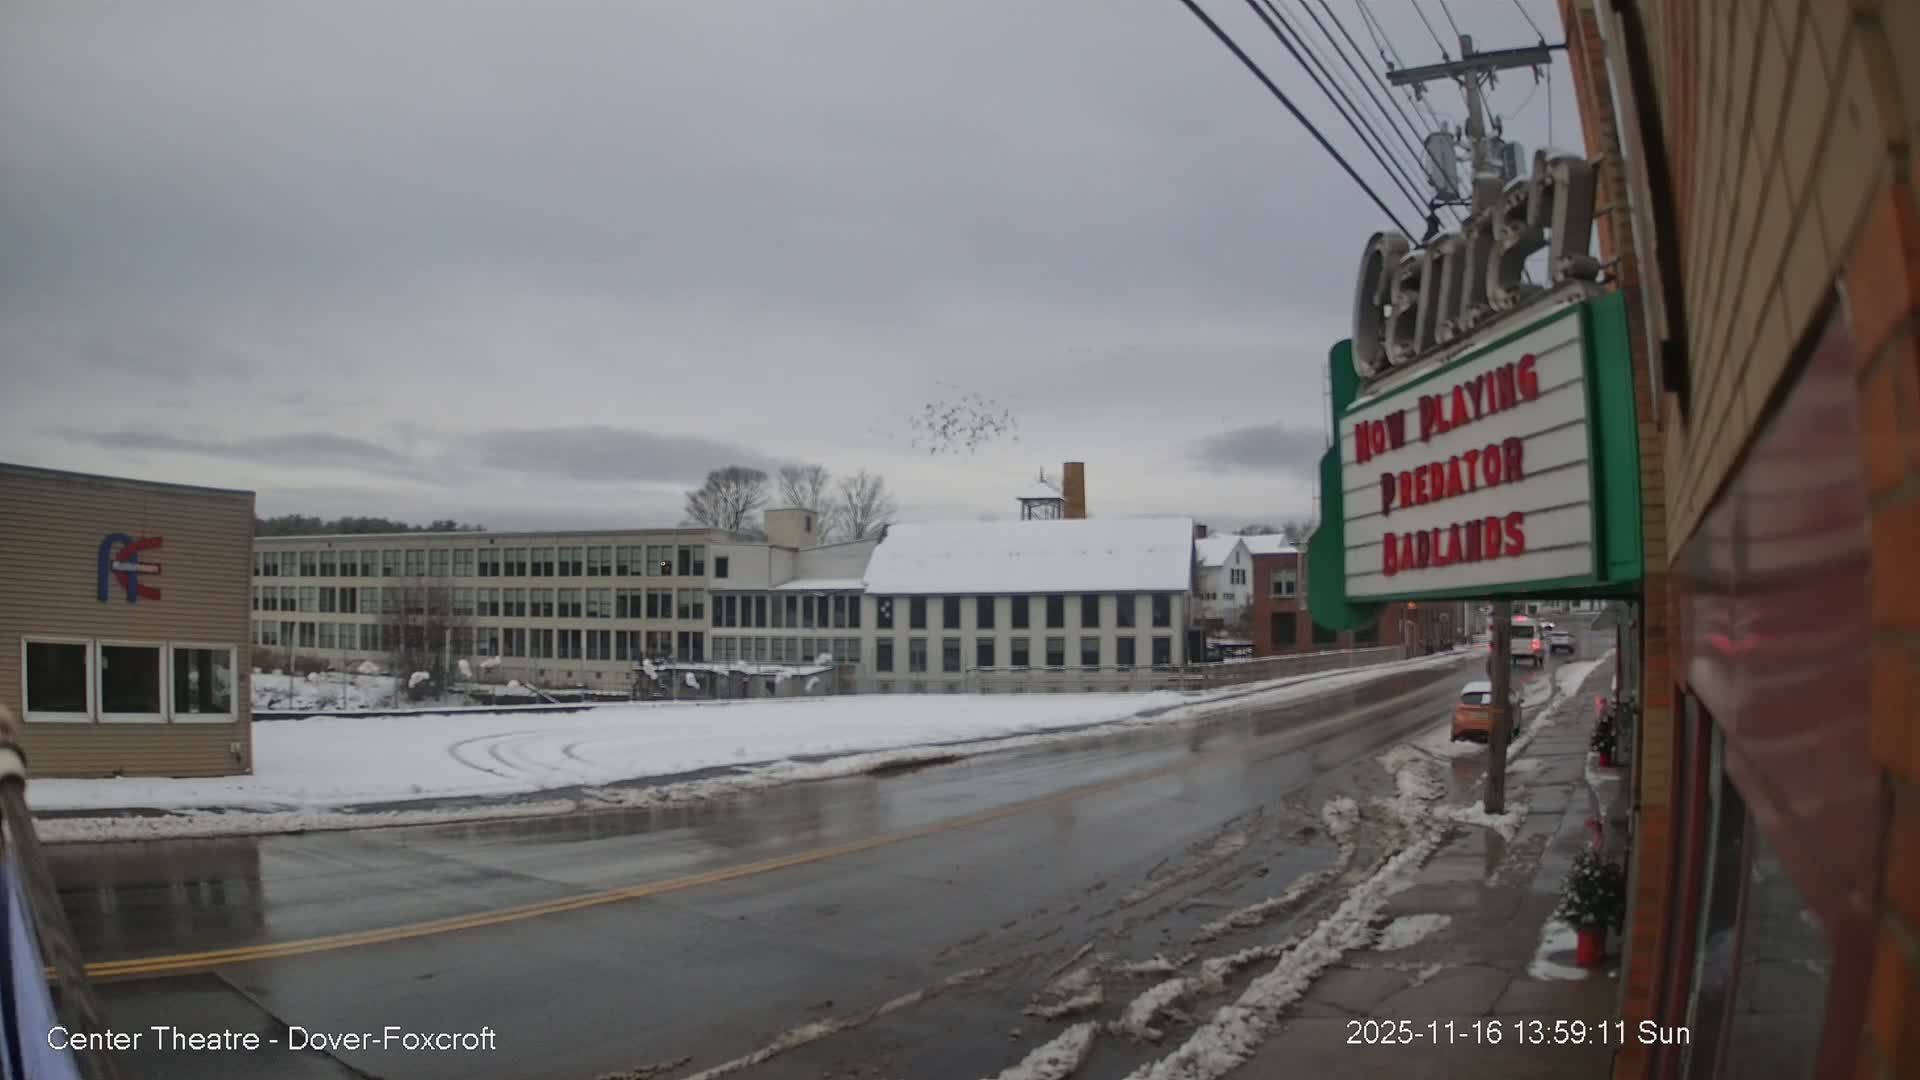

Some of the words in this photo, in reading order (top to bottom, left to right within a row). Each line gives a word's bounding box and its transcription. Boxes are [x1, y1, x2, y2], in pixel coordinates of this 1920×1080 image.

[1355, 409, 1405, 464] NOW
[1418, 353, 1540, 442] PLAYING
[1380, 437, 1525, 517] PREDATOR
[1382, 512, 1526, 576] BADLANDS
